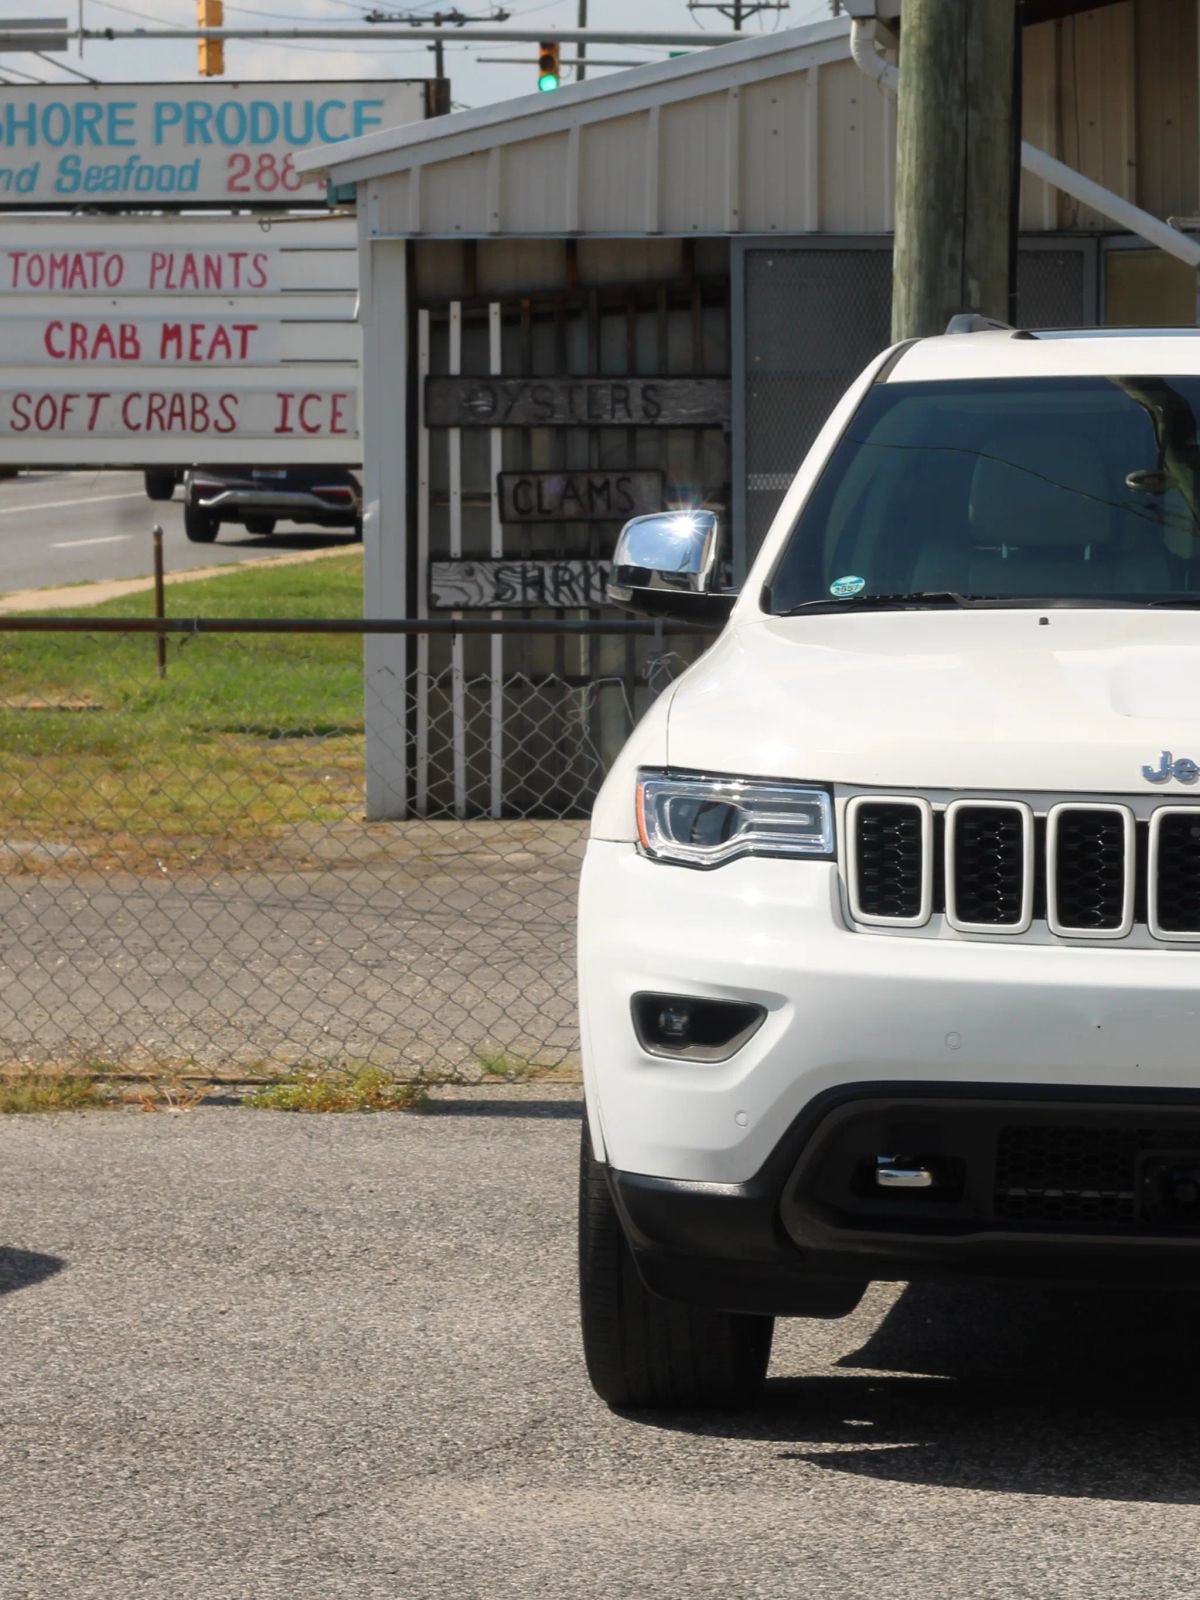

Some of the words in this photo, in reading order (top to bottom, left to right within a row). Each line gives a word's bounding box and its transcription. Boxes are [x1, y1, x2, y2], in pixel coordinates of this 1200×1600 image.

[0, 102, 137, 147] HORE
[55, 154, 201, 194] Seafood
[8, 252, 124, 289] TOMATO
[149, 252, 269, 289] PLANTS
[44, 321, 141, 360] CRAB
[160, 323, 258, 361] MEAT
[10, 393, 111, 432] SOFT
[122, 393, 239, 433] CRABS
[273, 393, 348, 433] ICE
[466, 383, 663, 421] OYSTERS
[512, 477, 636, 516] CLAMS
[493, 564, 610, 603] SHRI
